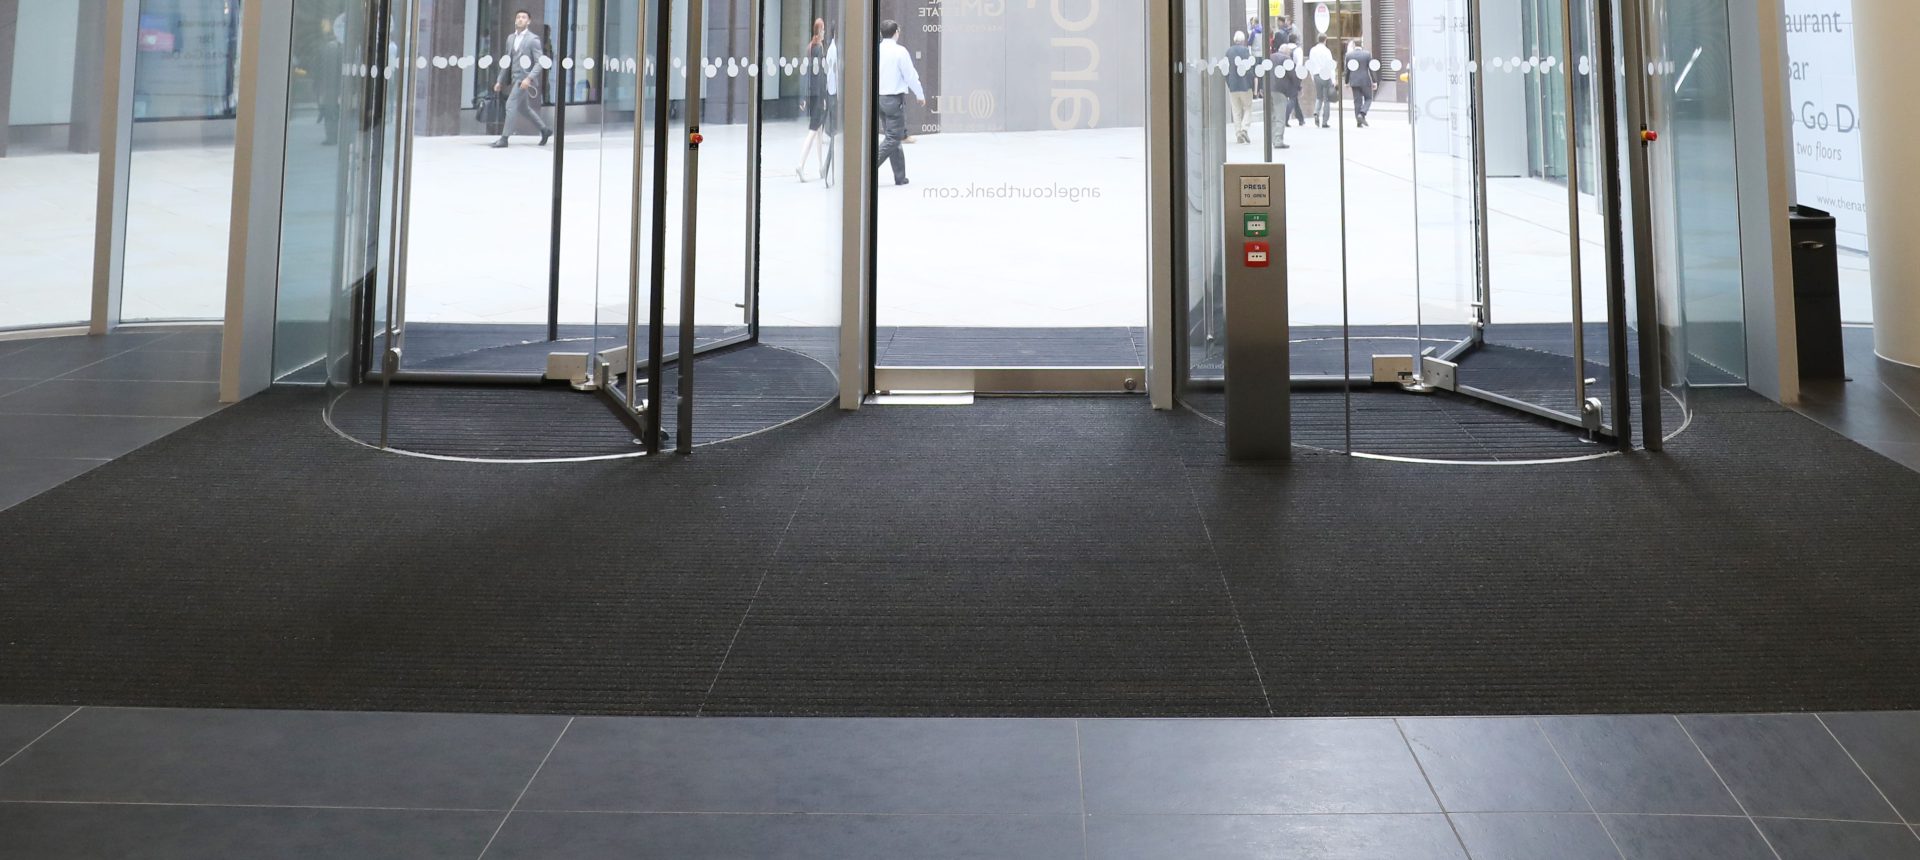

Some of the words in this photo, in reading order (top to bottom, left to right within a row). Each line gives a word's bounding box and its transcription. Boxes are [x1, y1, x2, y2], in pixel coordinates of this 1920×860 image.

[1801, 100, 1829, 131] Go
[1836, 103, 1860, 133] D
[1796, 141, 1813, 157] two
[1815, 140, 1843, 162] floors
